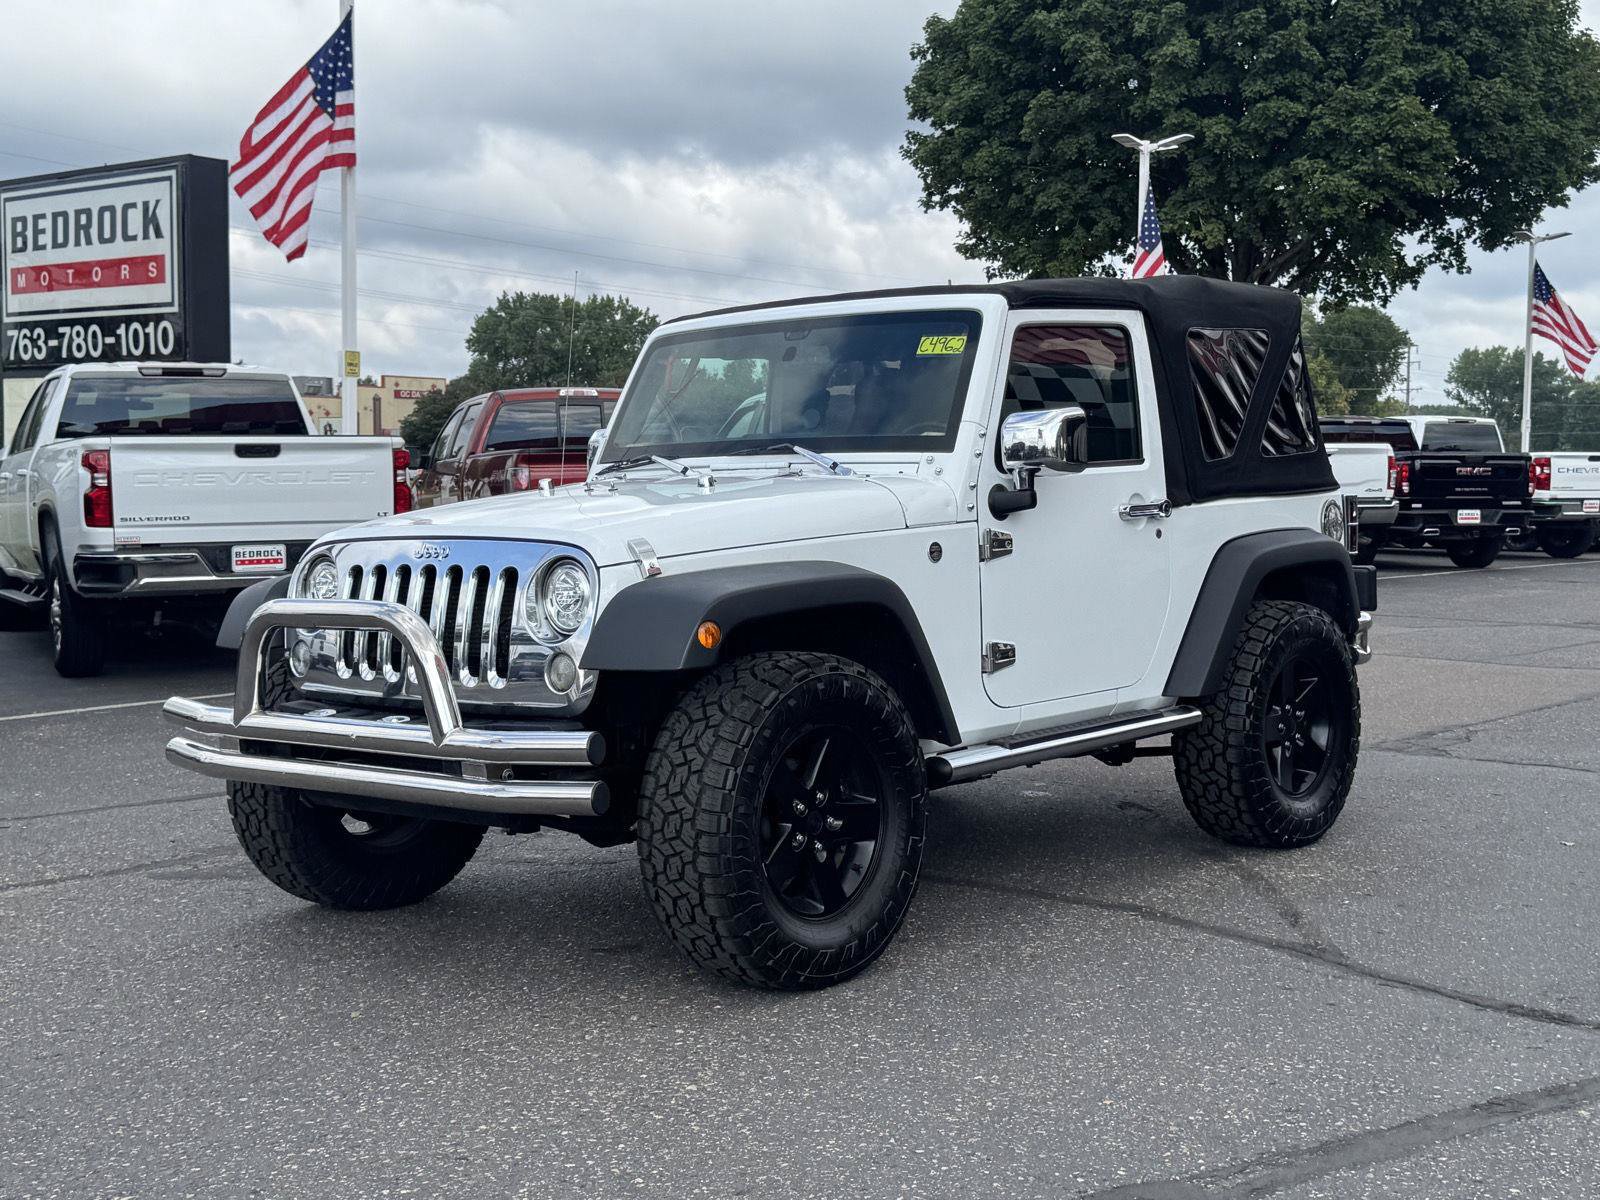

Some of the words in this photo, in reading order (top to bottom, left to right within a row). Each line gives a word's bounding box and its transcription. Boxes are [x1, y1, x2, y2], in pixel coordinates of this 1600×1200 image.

[11, 199, 164, 254] BEDROCK
[17, 262, 158, 289] MOTORS
[6, 320, 175, 361] 763-780-1010
[919, 337, 965, 353] C4962
[133, 471, 377, 487] CHEVROLET
[119, 515, 191, 523] SILVERADO
[234, 550, 283, 559] BEDROCK
[414, 542, 451, 561] Jeep
